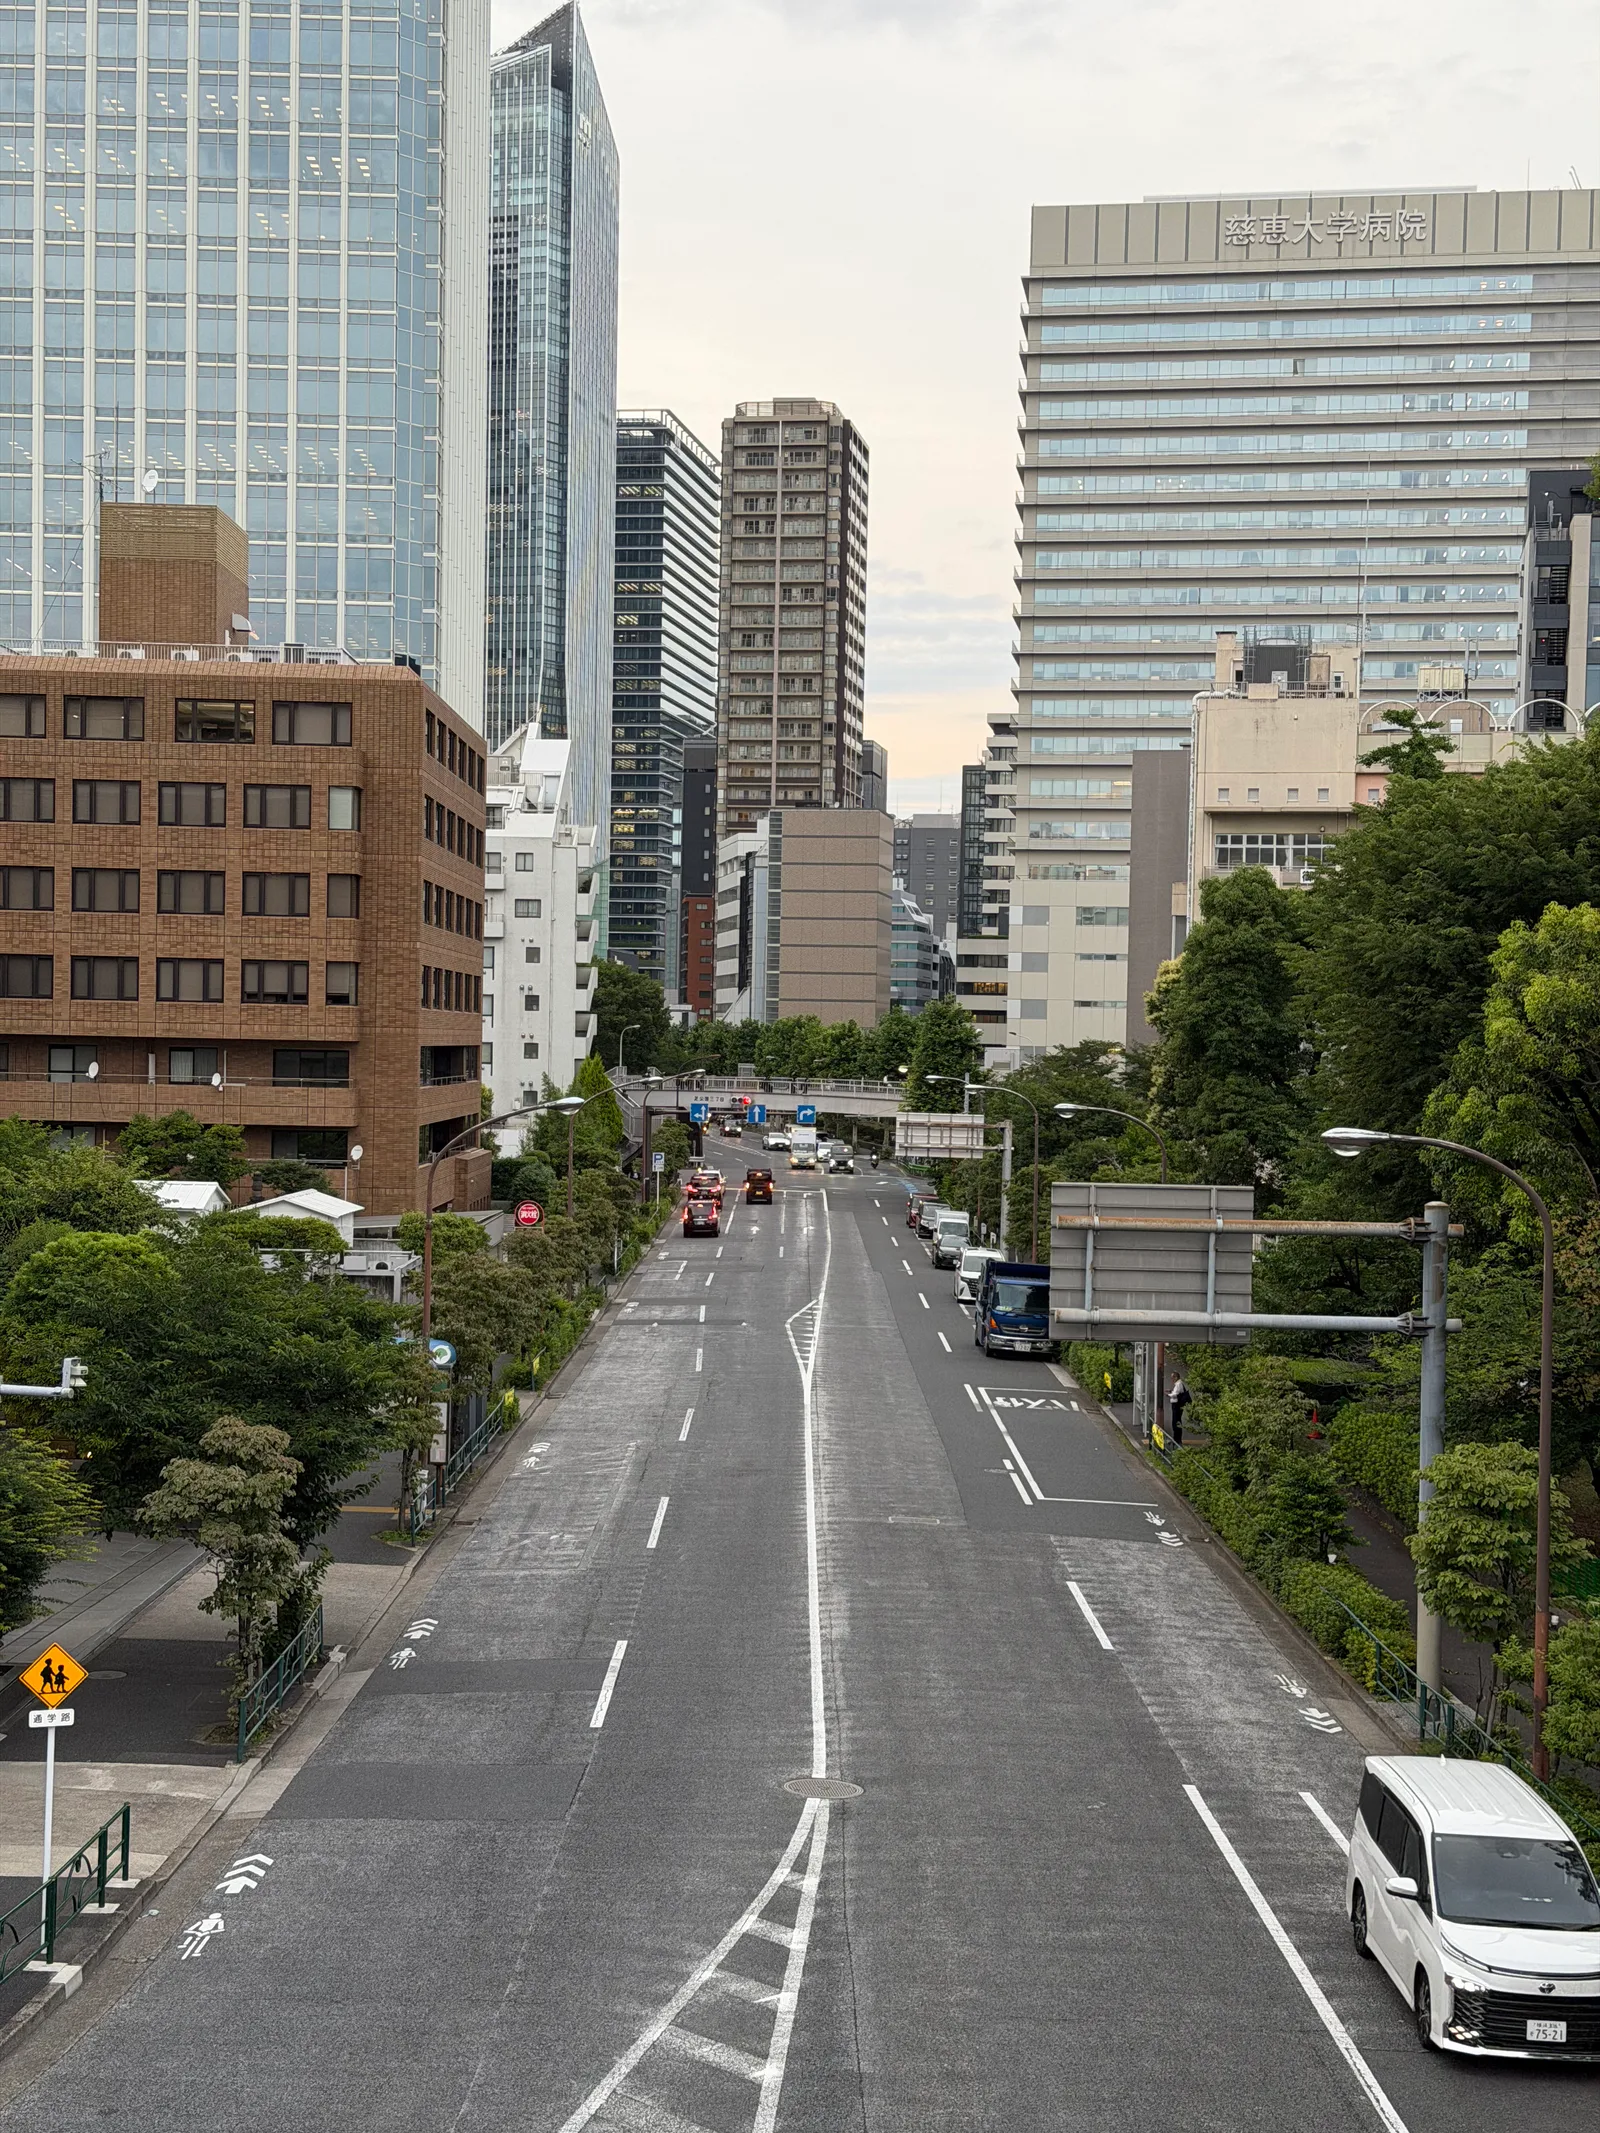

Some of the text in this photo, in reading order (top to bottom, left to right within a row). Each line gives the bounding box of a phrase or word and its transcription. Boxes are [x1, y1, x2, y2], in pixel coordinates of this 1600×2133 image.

[1224, 208, 1428, 246] 慈恵大学病院
[654, 1154, 663, 1163] P
[993, 1397, 1080, 1411] バス停
[33, 1712, 71, 1723] 通学路
[1535, 2029, 1563, 2040] 75-21
